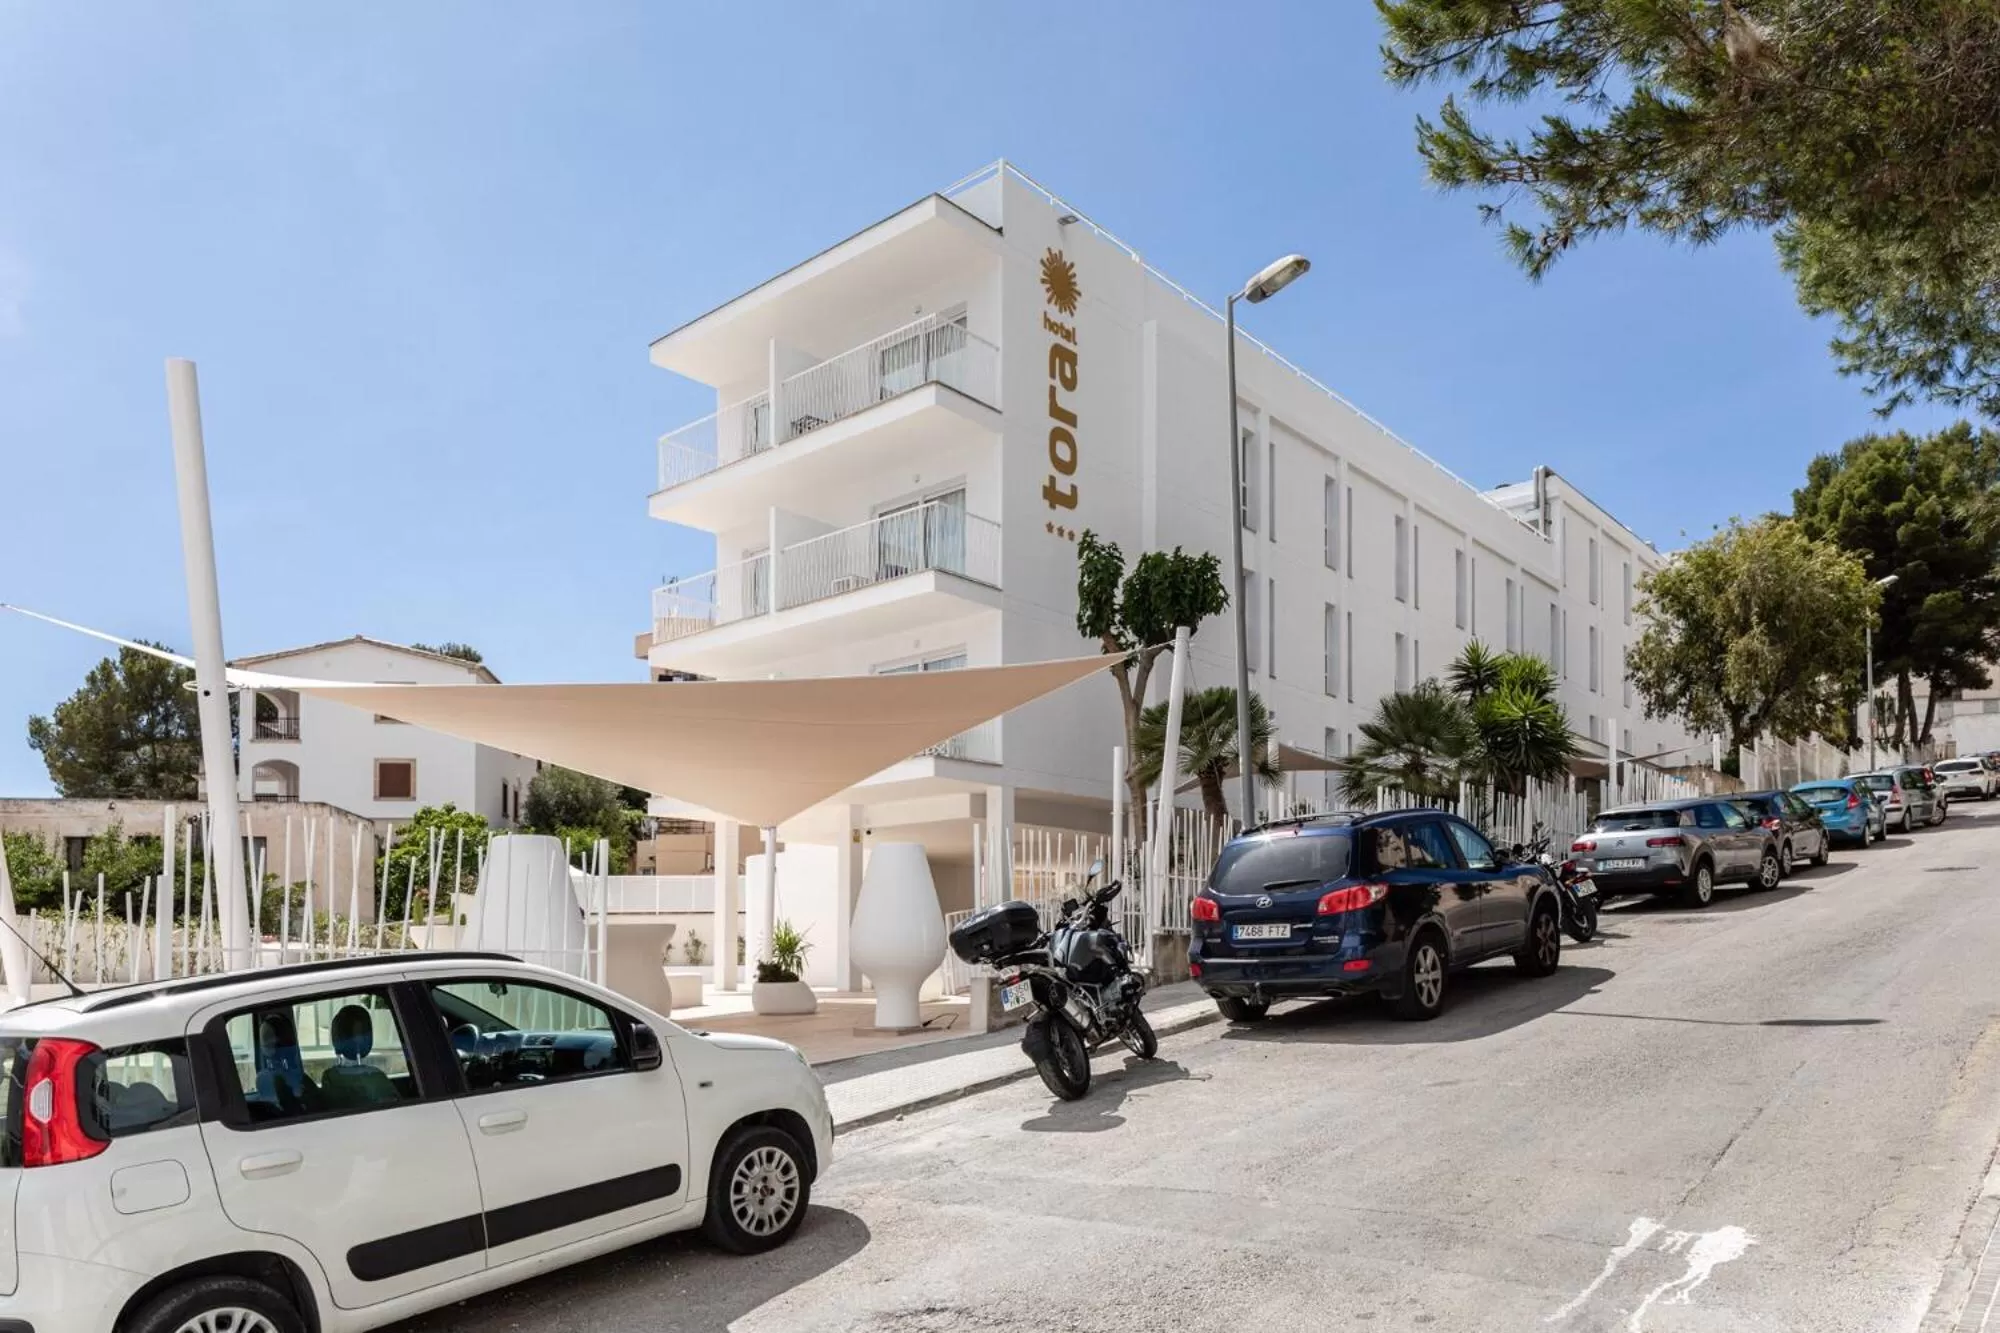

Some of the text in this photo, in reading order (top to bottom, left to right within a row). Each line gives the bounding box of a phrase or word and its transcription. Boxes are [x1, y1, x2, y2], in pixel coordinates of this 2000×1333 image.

[1043, 311, 1078, 345] hotel
[1042, 343, 1078, 510] tora
[1239, 924, 1288, 937] 7468 FTZ
